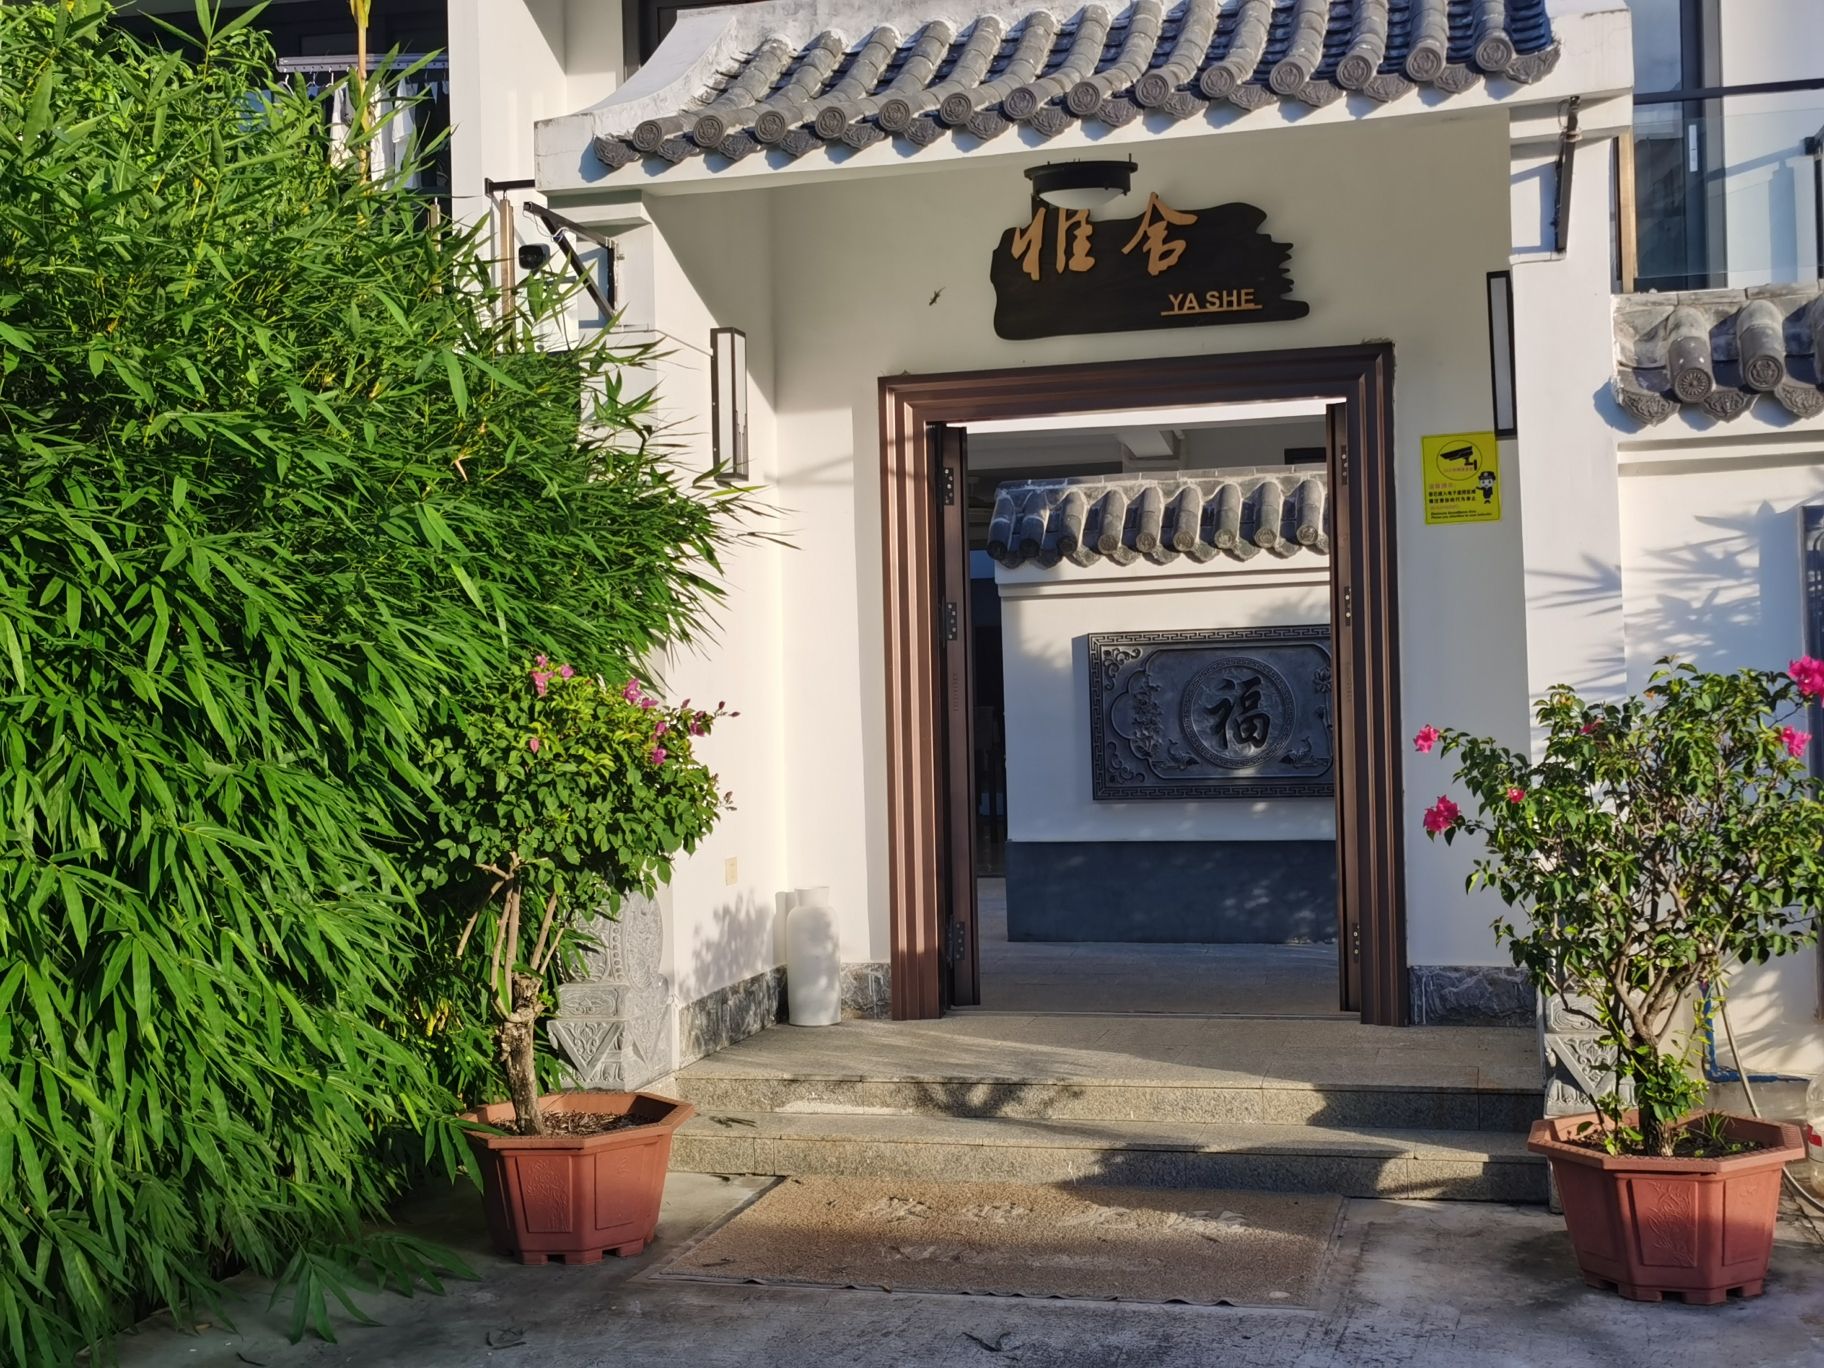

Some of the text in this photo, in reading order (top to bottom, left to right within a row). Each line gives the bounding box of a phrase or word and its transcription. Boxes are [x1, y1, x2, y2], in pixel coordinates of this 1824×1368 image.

[1168, 288, 1255, 312] YA SHE
[1205, 676, 1271, 749] 福
